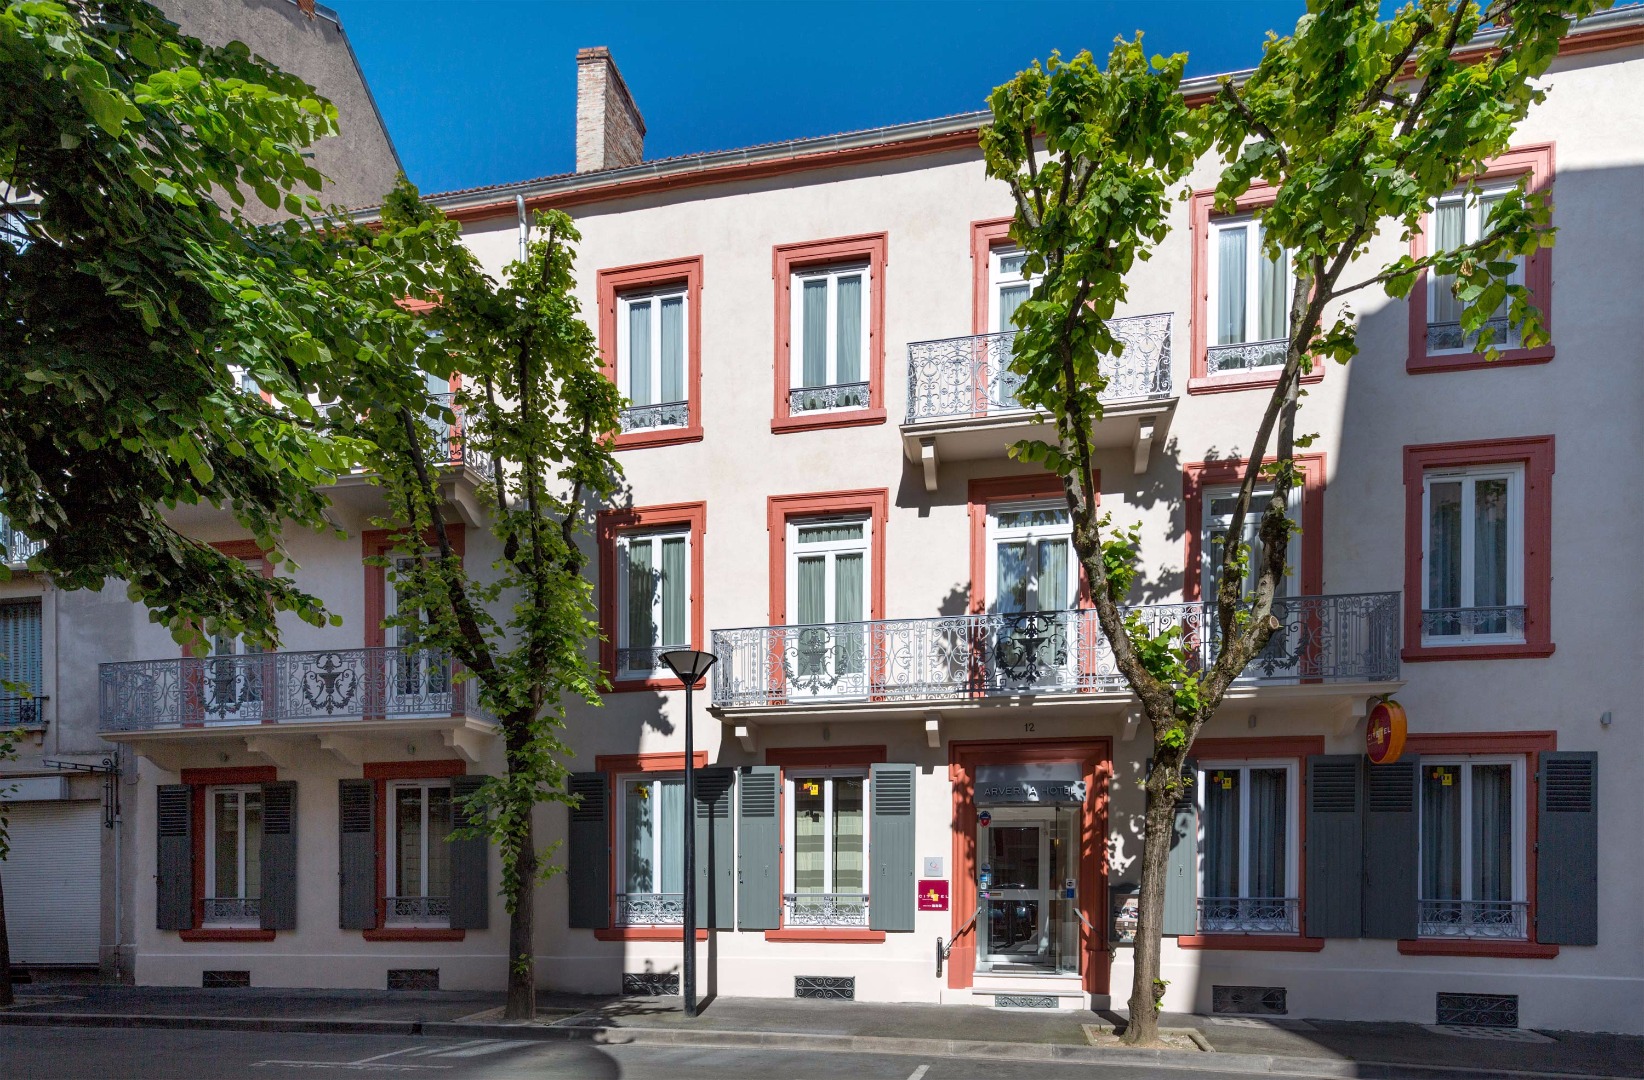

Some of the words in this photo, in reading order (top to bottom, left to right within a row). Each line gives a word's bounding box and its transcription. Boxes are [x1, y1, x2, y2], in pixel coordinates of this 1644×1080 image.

[1024, 722, 1035, 732] 12
[984, 786, 1037, 796] ARVERNA
[1042, 785, 1077, 795] HOTEL
